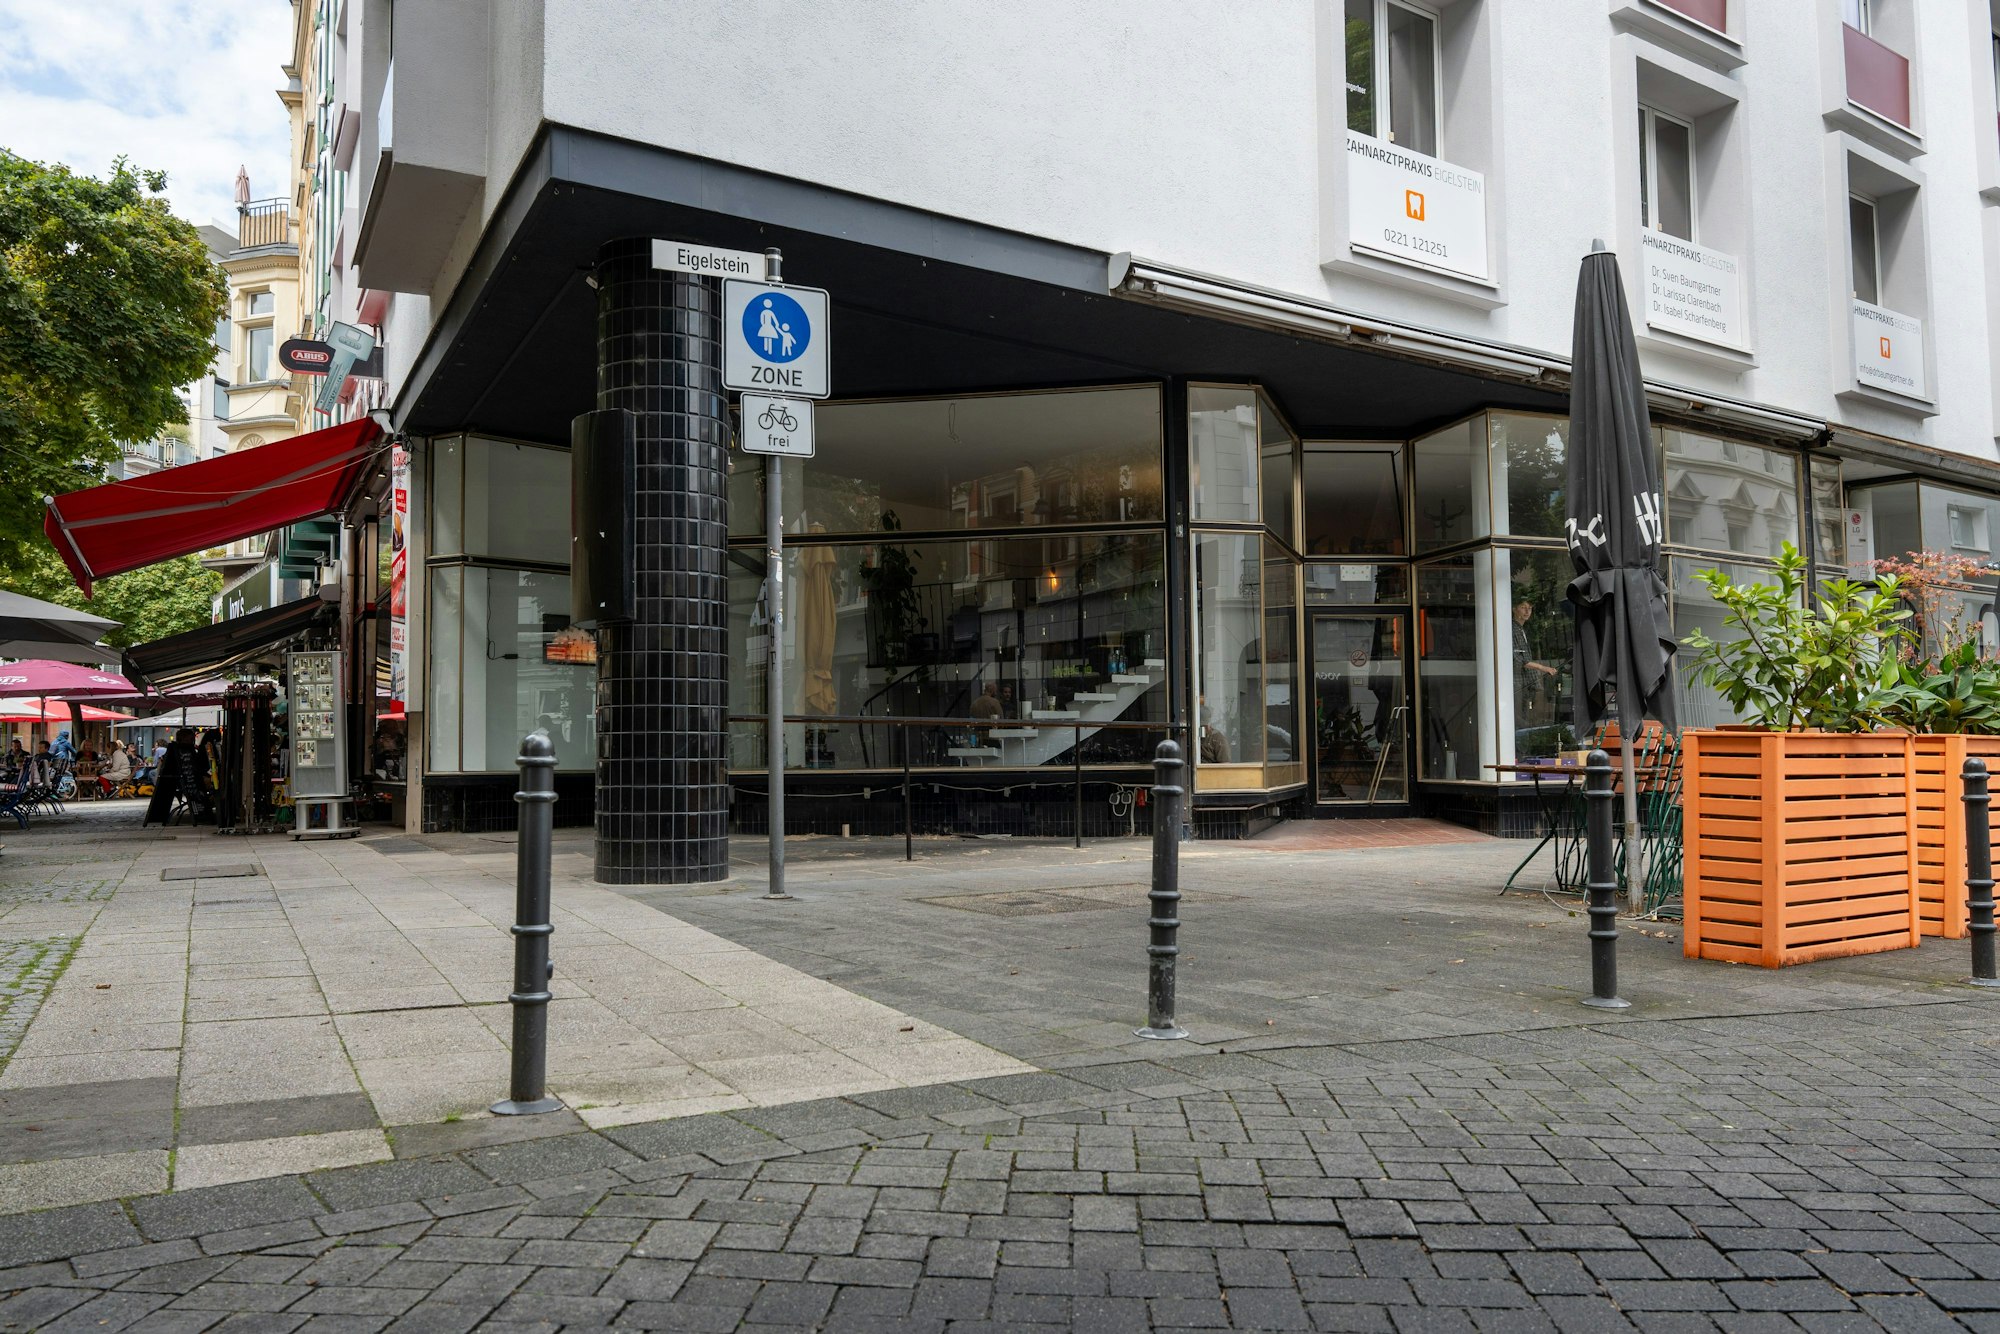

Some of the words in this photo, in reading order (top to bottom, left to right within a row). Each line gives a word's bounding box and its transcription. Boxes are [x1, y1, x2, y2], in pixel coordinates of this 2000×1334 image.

[1347, 138, 1432, 177] ZAHNARZTPRAXIS
[1434, 167, 1481, 194] EIGELSTEIN
[1384, 228, 1408, 246] 0221
[1412, 236, 1448, 258] 121251
[1642, 234, 1701, 263] AHNARZTPRAXIS
[1702, 254, 1736, 275] EIGELSTEIN
[677, 248, 749, 274] Eigelstein
[1652, 265, 1661, 278] Dr.
[1663, 268, 1679, 283] Sven
[1680, 274, 1720, 296] Baumgartner
[1652, 282, 1662, 296] Dr.
[1663, 286, 1686, 303] Larissa
[1687, 293, 1721, 313] Clarenbach
[1653, 300, 1663, 313] Dr.
[1664, 303, 1683, 319] Isabel
[1684, 309, 1727, 334] Scharfenberg
[1853, 304, 1894, 327] HNARZTPRAXIS
[296, 352, 324, 360] ABUS
[751, 365, 803, 387] ZONE
[767, 434, 790, 447] frei
